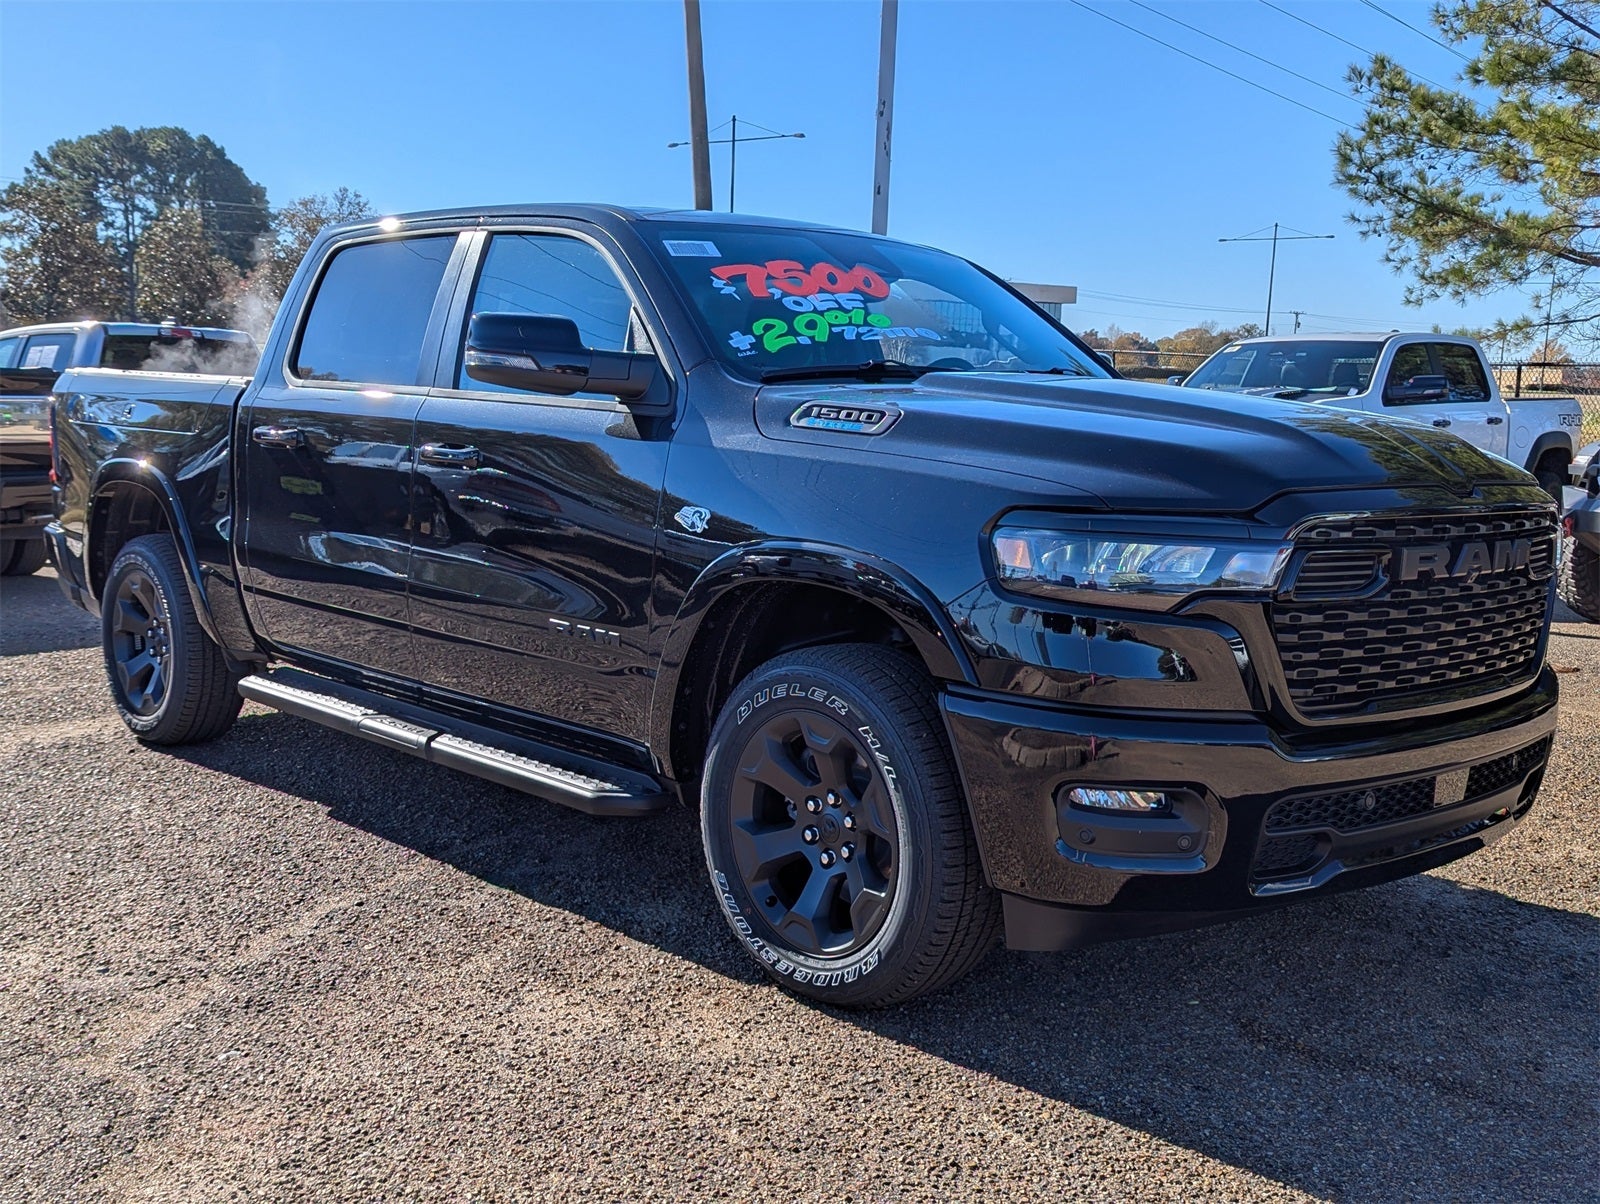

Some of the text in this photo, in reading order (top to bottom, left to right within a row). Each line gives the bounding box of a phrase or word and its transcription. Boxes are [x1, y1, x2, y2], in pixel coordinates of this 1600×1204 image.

[811, 407, 881, 422] 1500
[1399, 539, 1531, 580] RAM
[736, 683, 849, 725] DUELER
[714, 869, 879, 987] BRIDGESTONE
